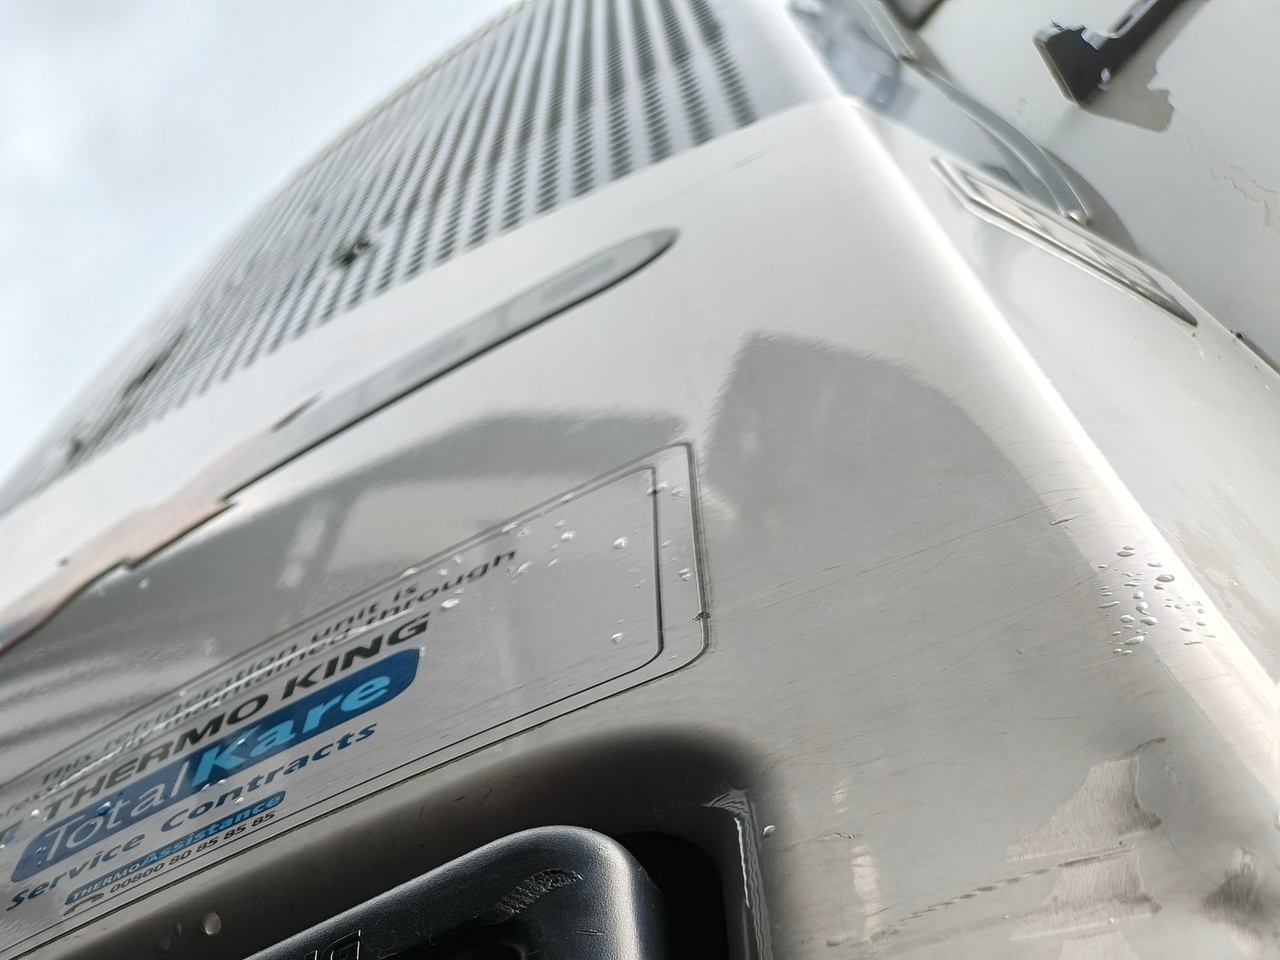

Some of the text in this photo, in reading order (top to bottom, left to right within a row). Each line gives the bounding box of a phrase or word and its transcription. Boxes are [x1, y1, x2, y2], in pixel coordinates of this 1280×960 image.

[42, 752, 92, 785] This
[310, 599, 379, 643] unit
[393, 582, 419, 602] is
[43, 612, 430, 821] THERMO KING
[110, 810, 276, 894] 00800 80 85 85 85
